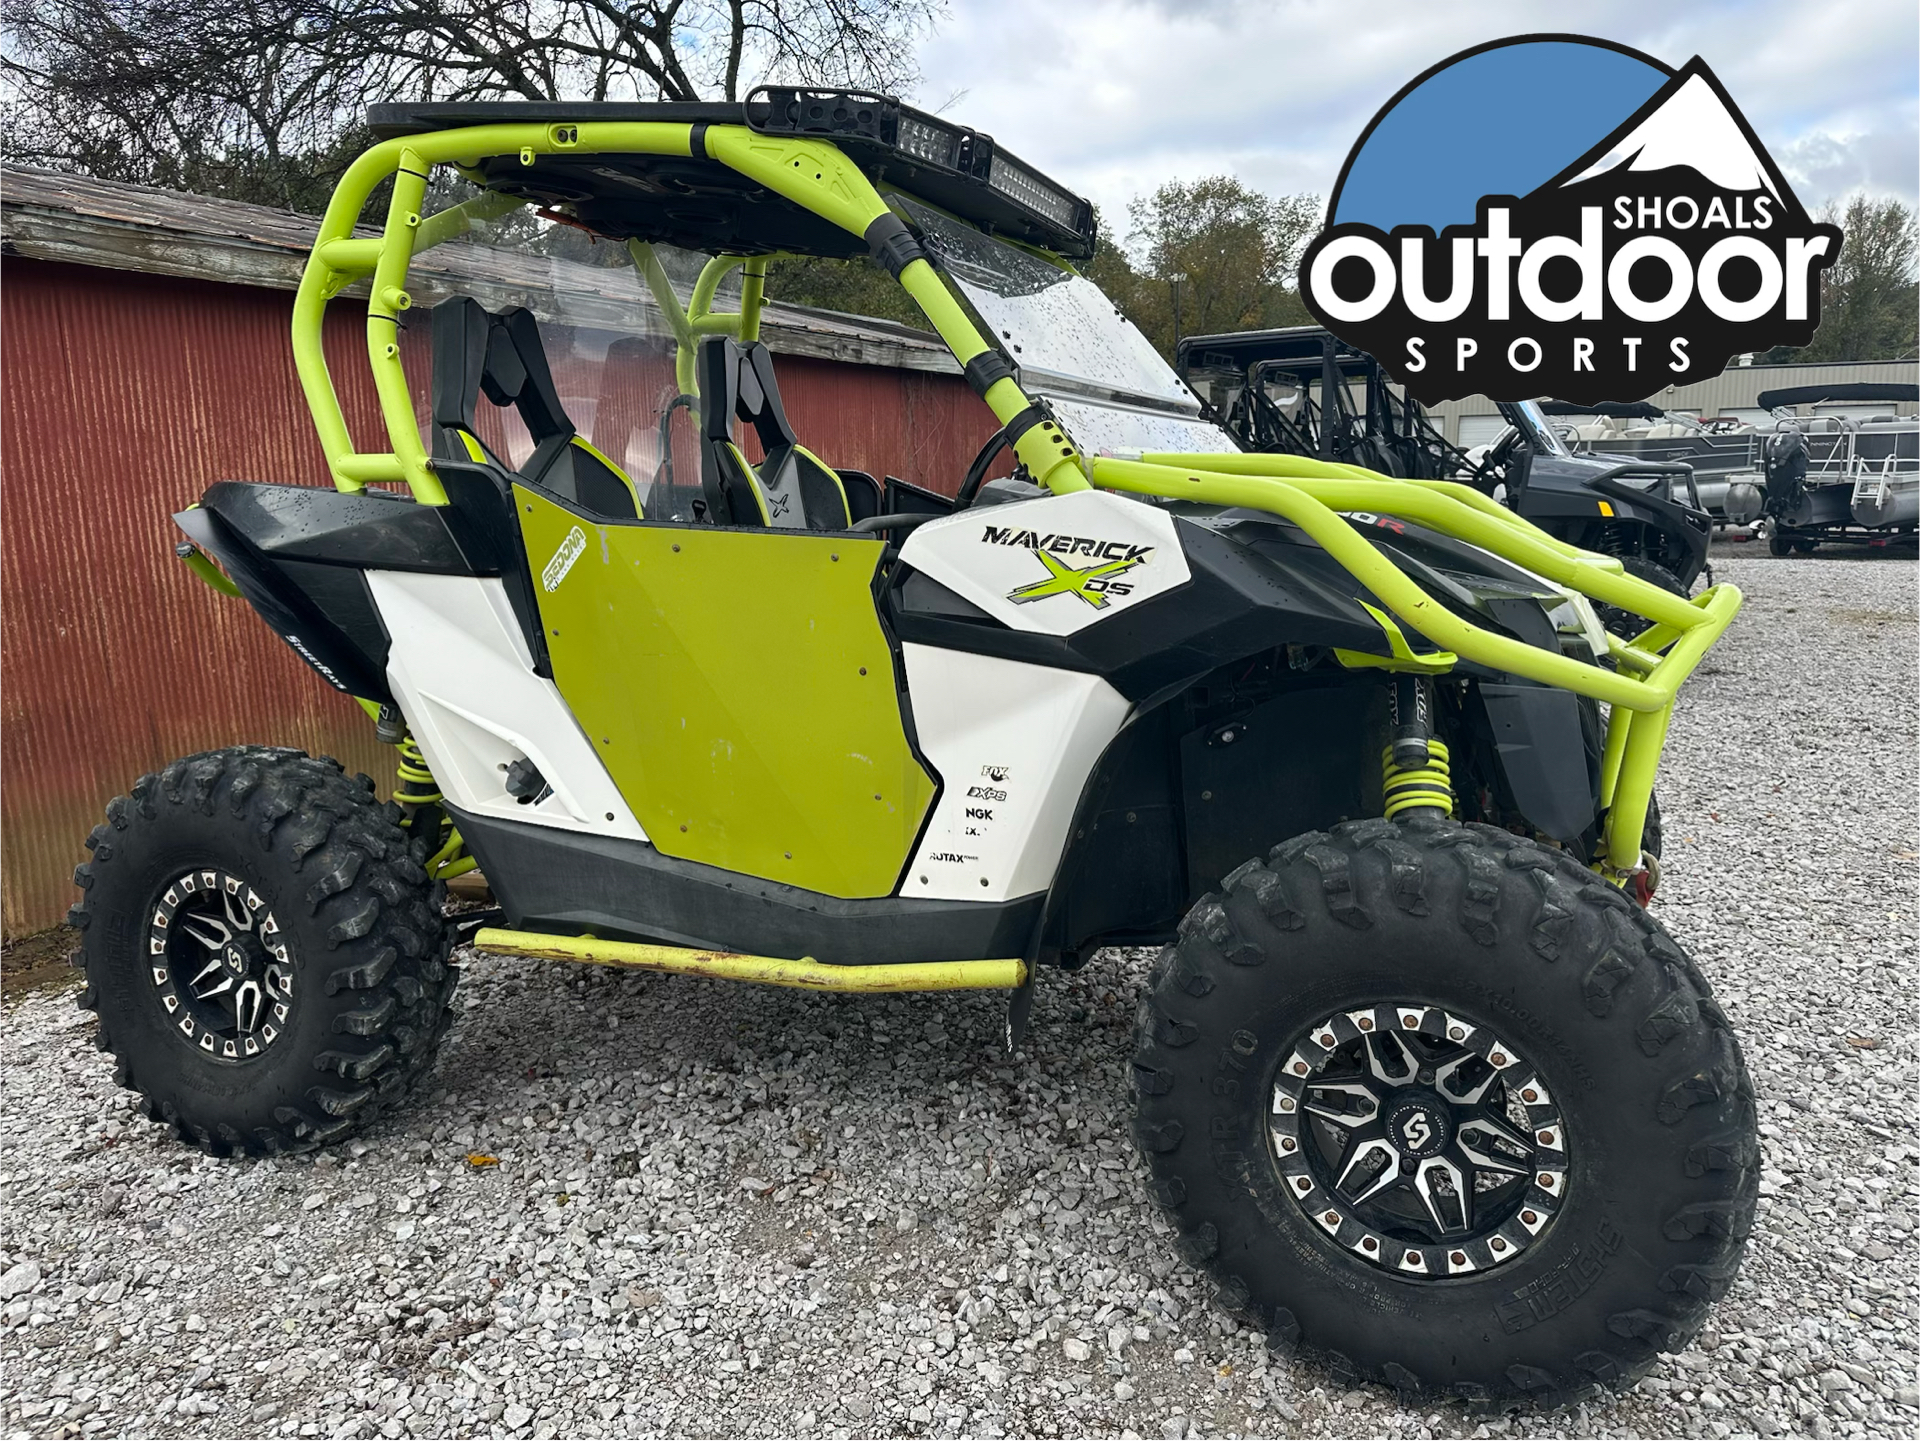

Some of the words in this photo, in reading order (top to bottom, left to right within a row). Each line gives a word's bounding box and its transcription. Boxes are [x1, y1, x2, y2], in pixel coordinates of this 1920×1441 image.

[543, 527, 585, 590] SEDONA
[982, 526, 1155, 564] MAVERICK
[981, 765, 1009, 780] FOX
[965, 807, 993, 821] NGK
[1212, 1029, 1258, 1100] 370
[1211, 1116, 1258, 1202] XTR
